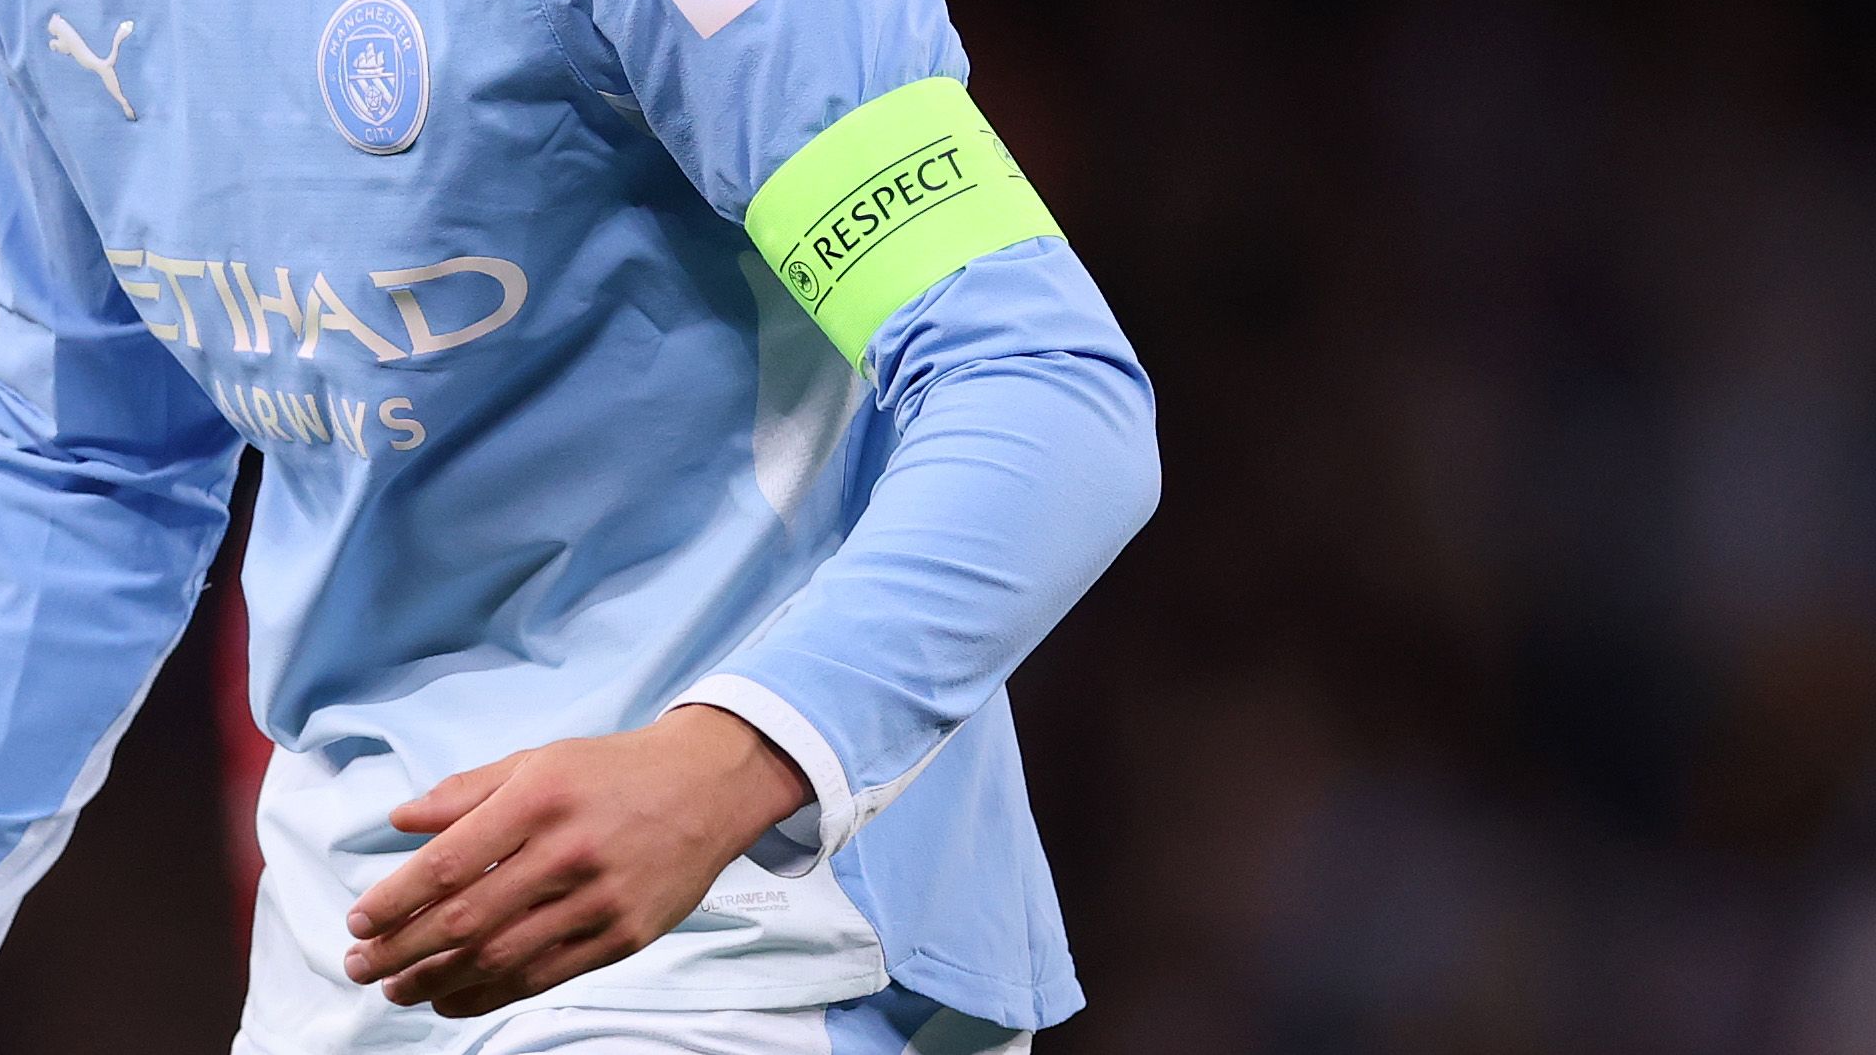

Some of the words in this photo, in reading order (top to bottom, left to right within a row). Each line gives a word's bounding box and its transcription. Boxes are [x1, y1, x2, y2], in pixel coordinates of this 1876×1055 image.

[329, 7, 412, 56] MANCHESTER
[365, 127, 394, 142] CITY
[813, 148, 963, 270] RESPECT
[104, 248, 528, 362] ETIHAD
[700, 890, 789, 912] ULTRAWEAVE
